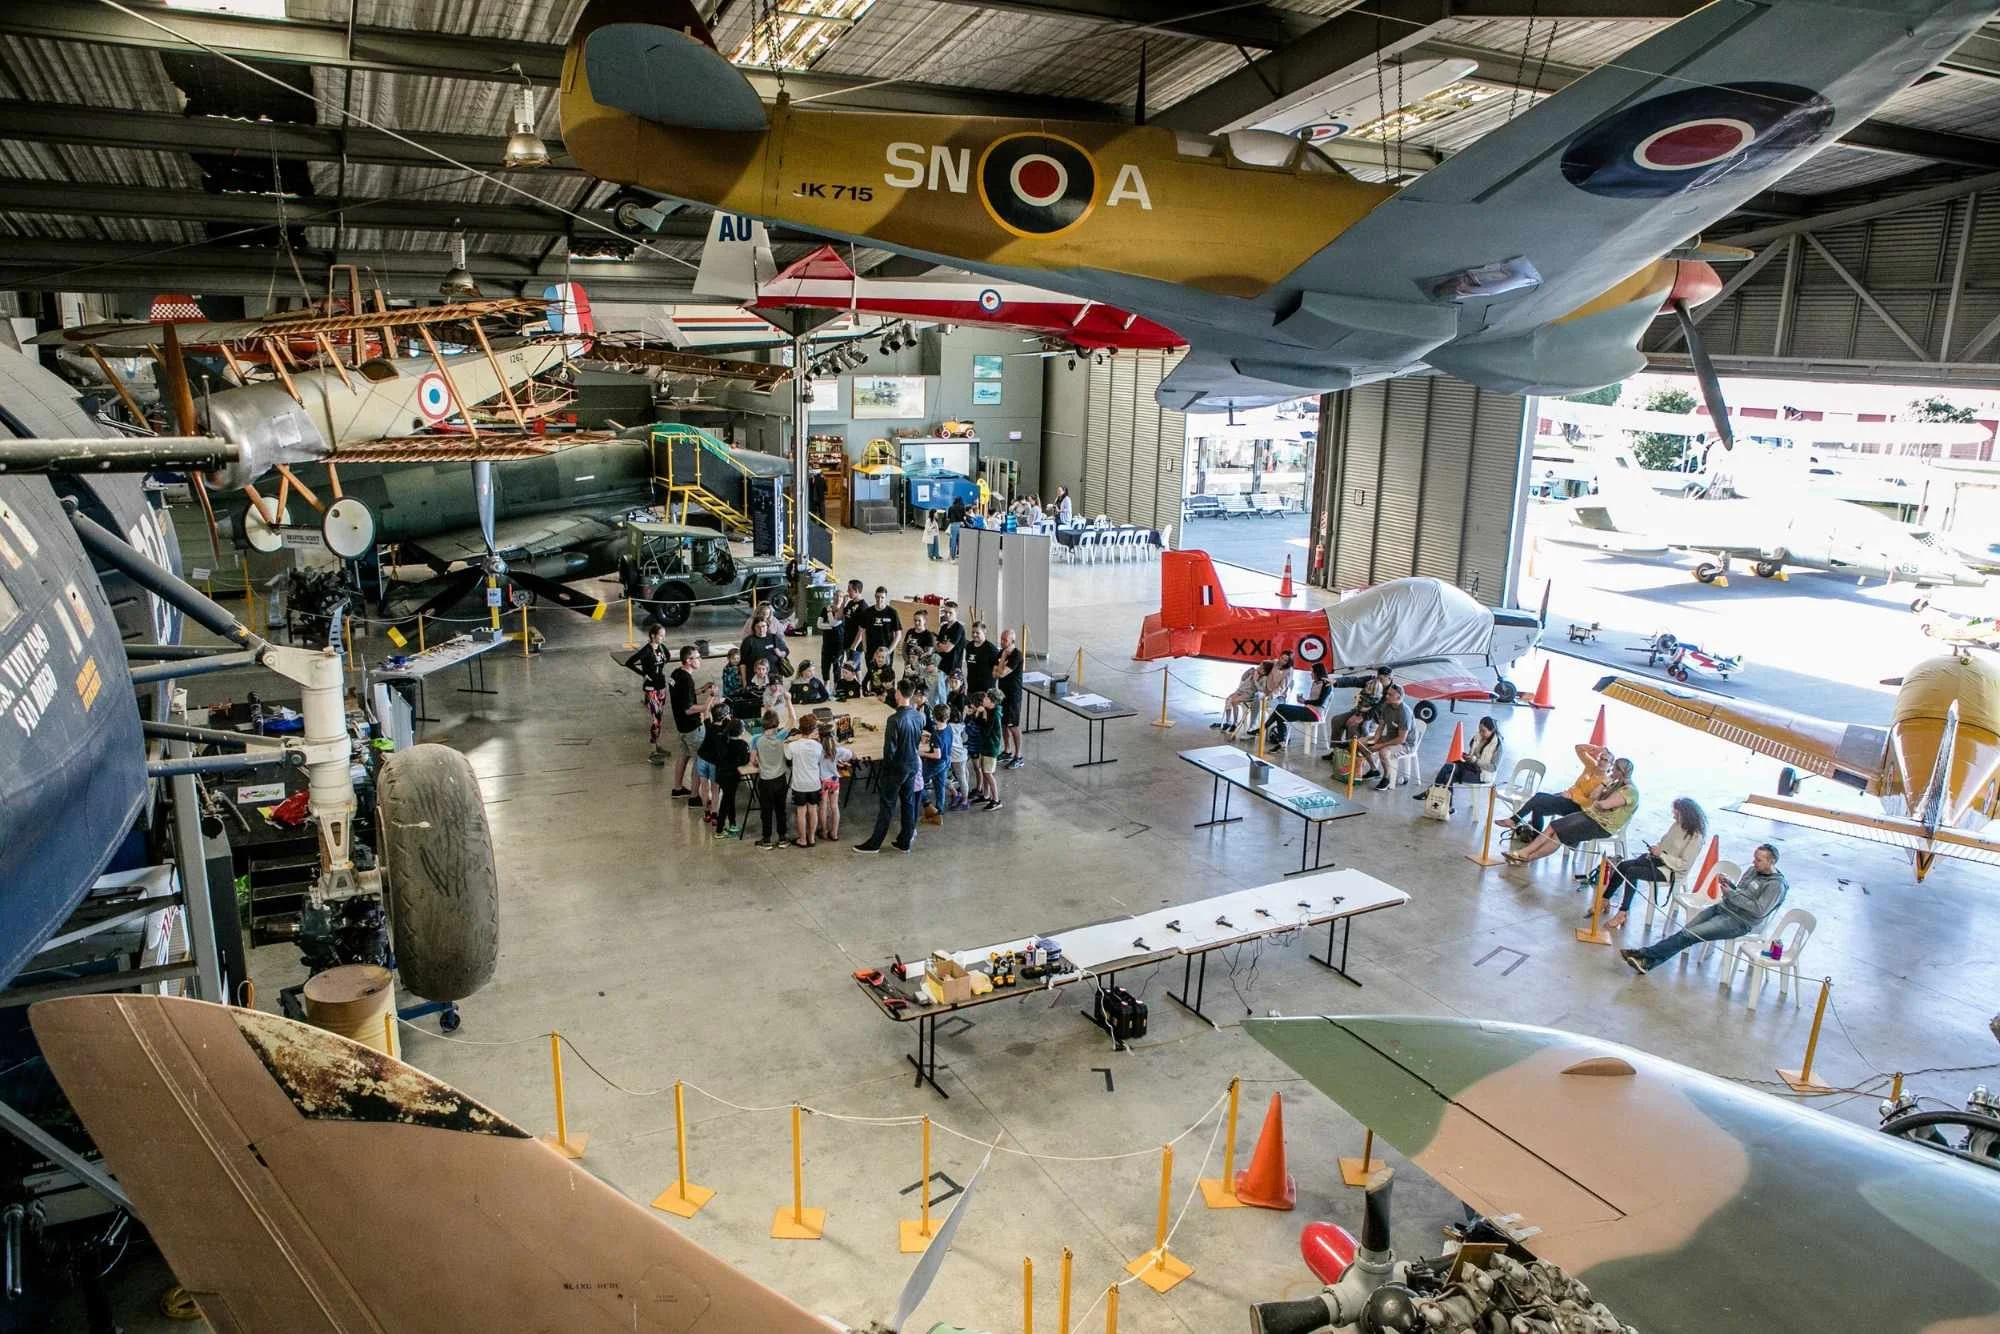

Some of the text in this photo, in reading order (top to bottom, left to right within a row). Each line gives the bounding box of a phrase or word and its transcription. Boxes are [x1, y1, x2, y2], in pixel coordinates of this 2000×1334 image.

[884, 142, 1152, 210] SN A
[794, 182, 873, 202] JK 715
[719, 215, 752, 242] AU
